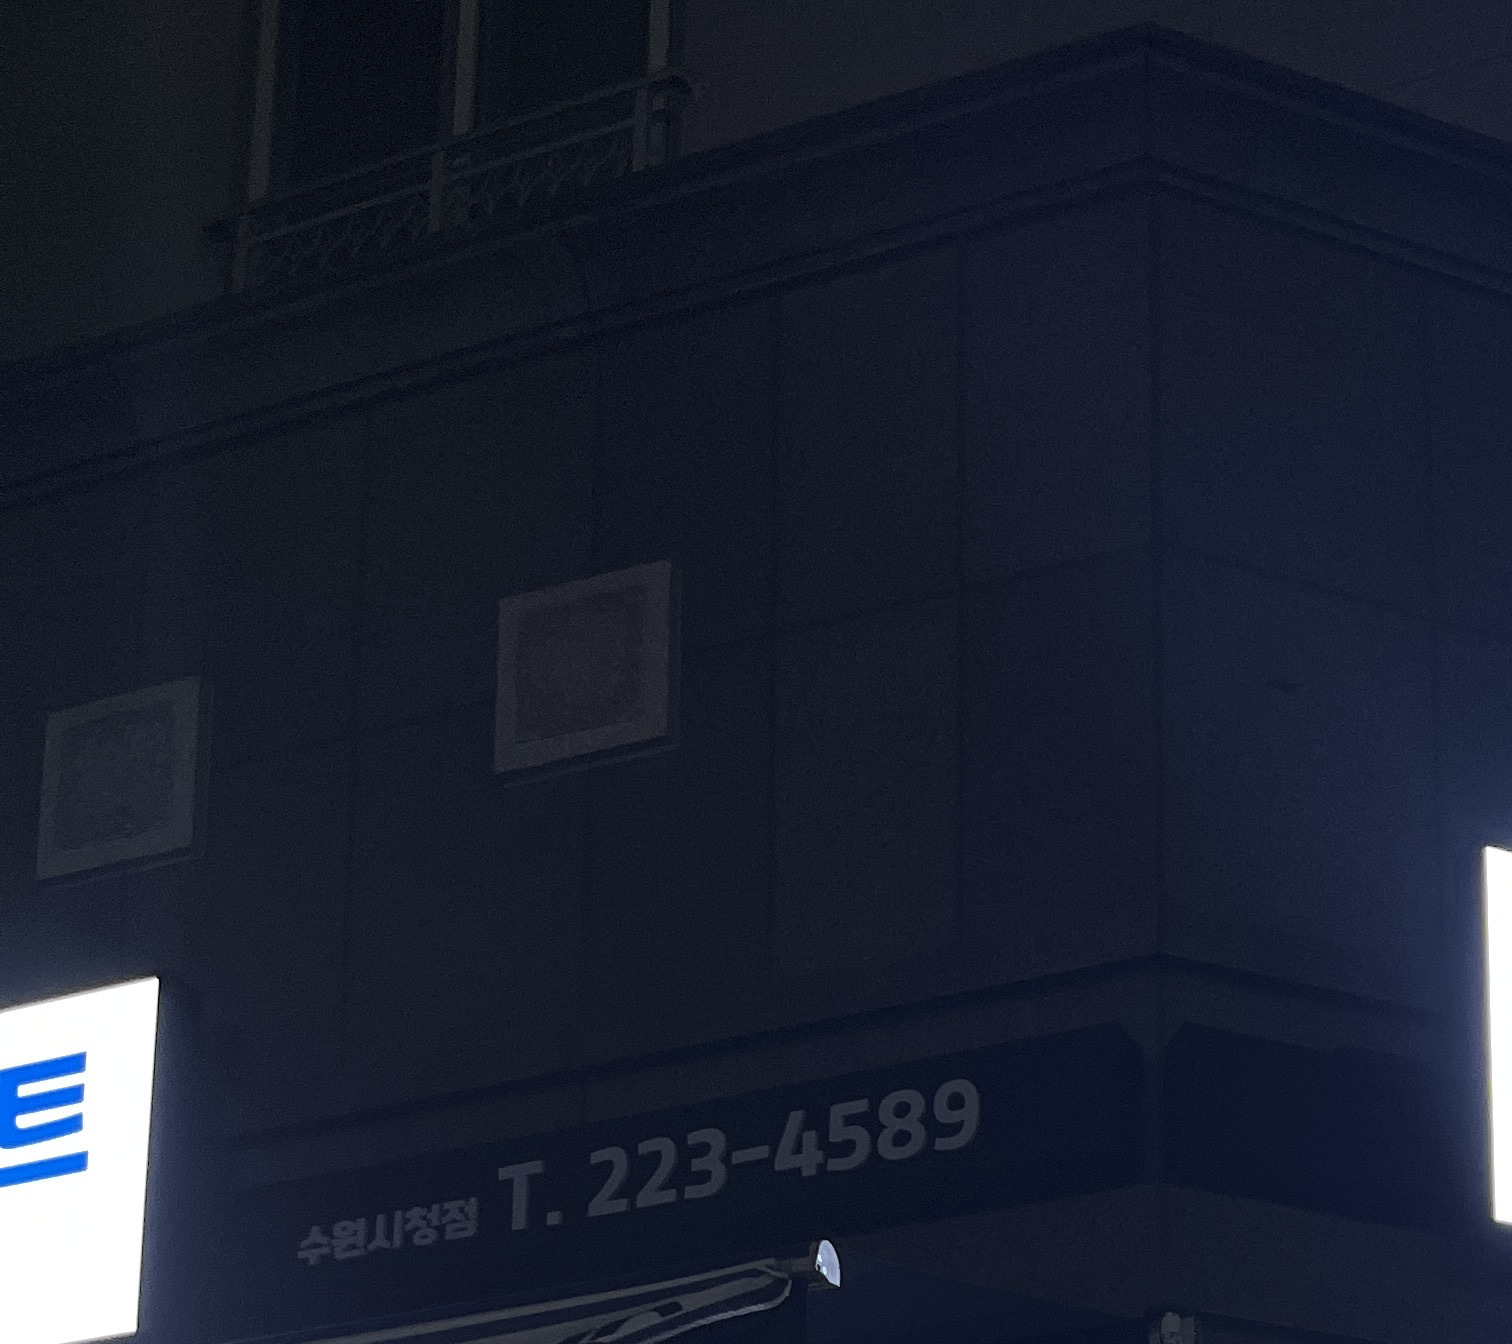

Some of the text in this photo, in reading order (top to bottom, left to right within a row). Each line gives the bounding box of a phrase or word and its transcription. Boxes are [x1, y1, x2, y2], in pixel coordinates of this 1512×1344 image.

[297, 1078, 981, 1266] 수원시청점 T. 223-4589
